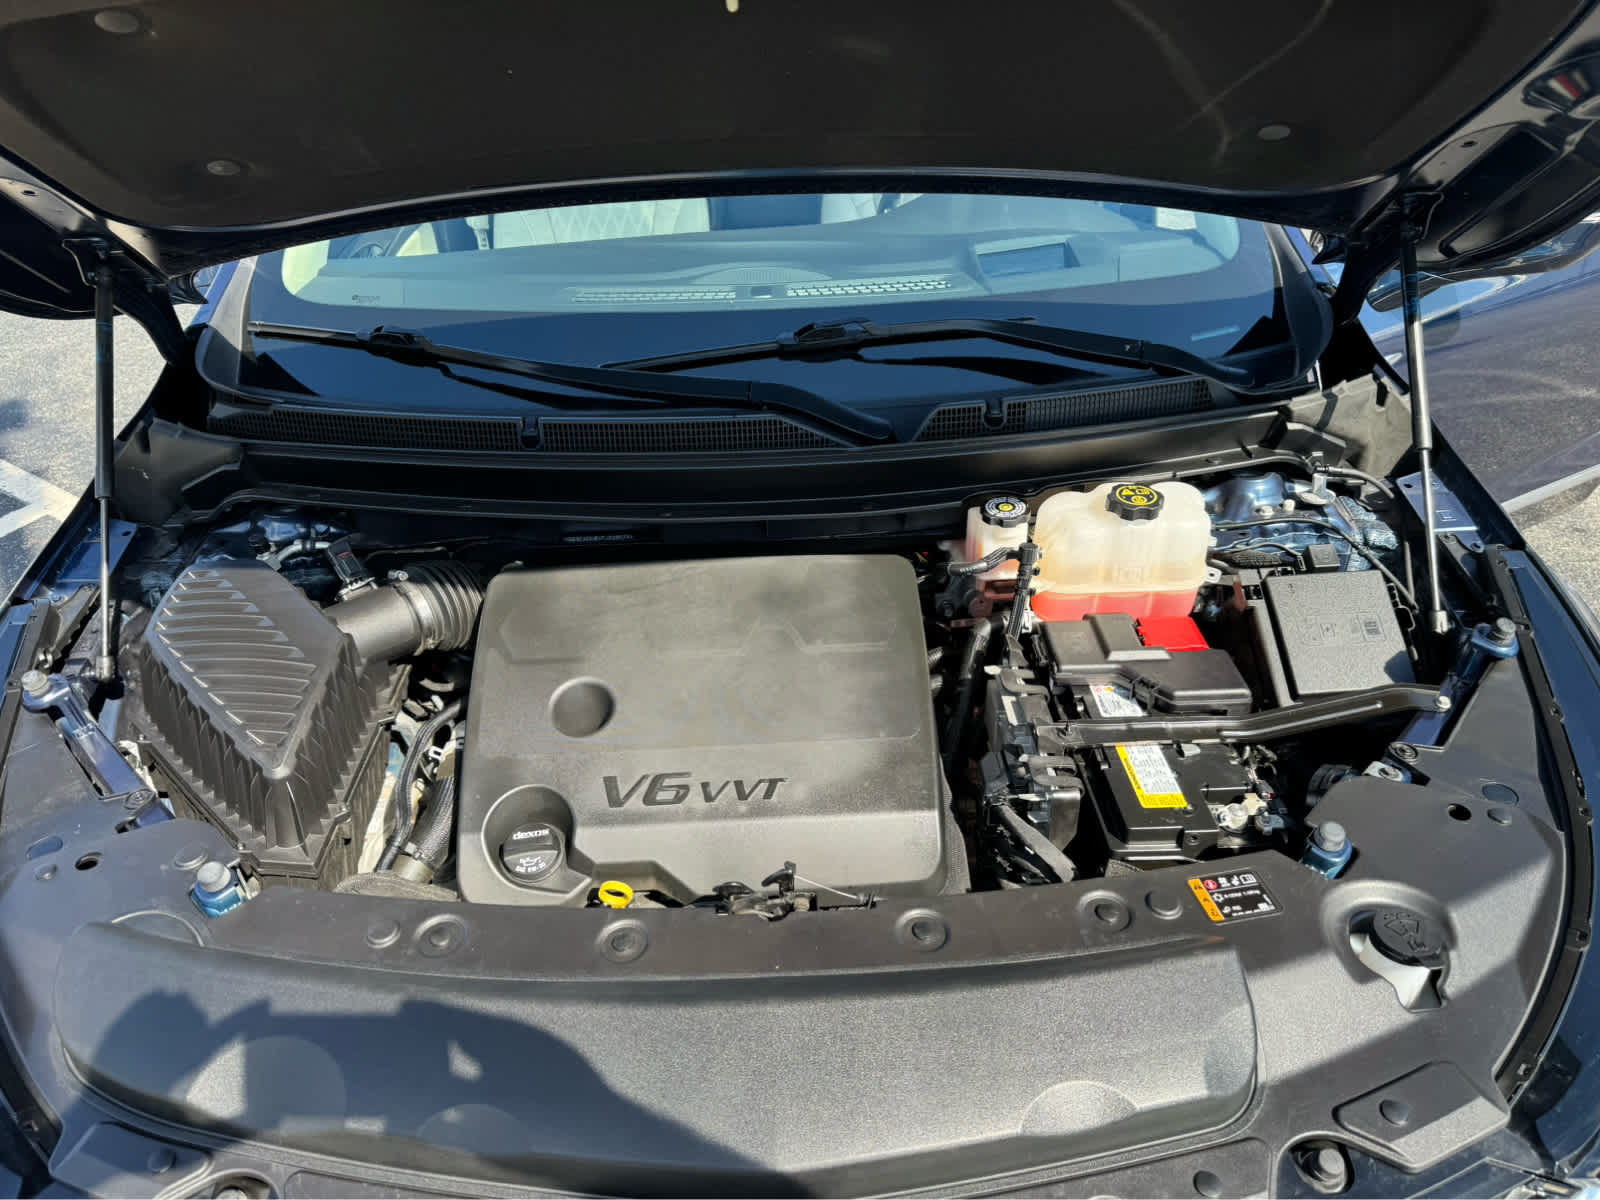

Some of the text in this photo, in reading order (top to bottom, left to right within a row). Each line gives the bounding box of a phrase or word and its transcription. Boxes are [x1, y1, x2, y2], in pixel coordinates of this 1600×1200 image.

[603, 772, 787, 808] V6 VVT
[513, 828, 550, 840] dexos
